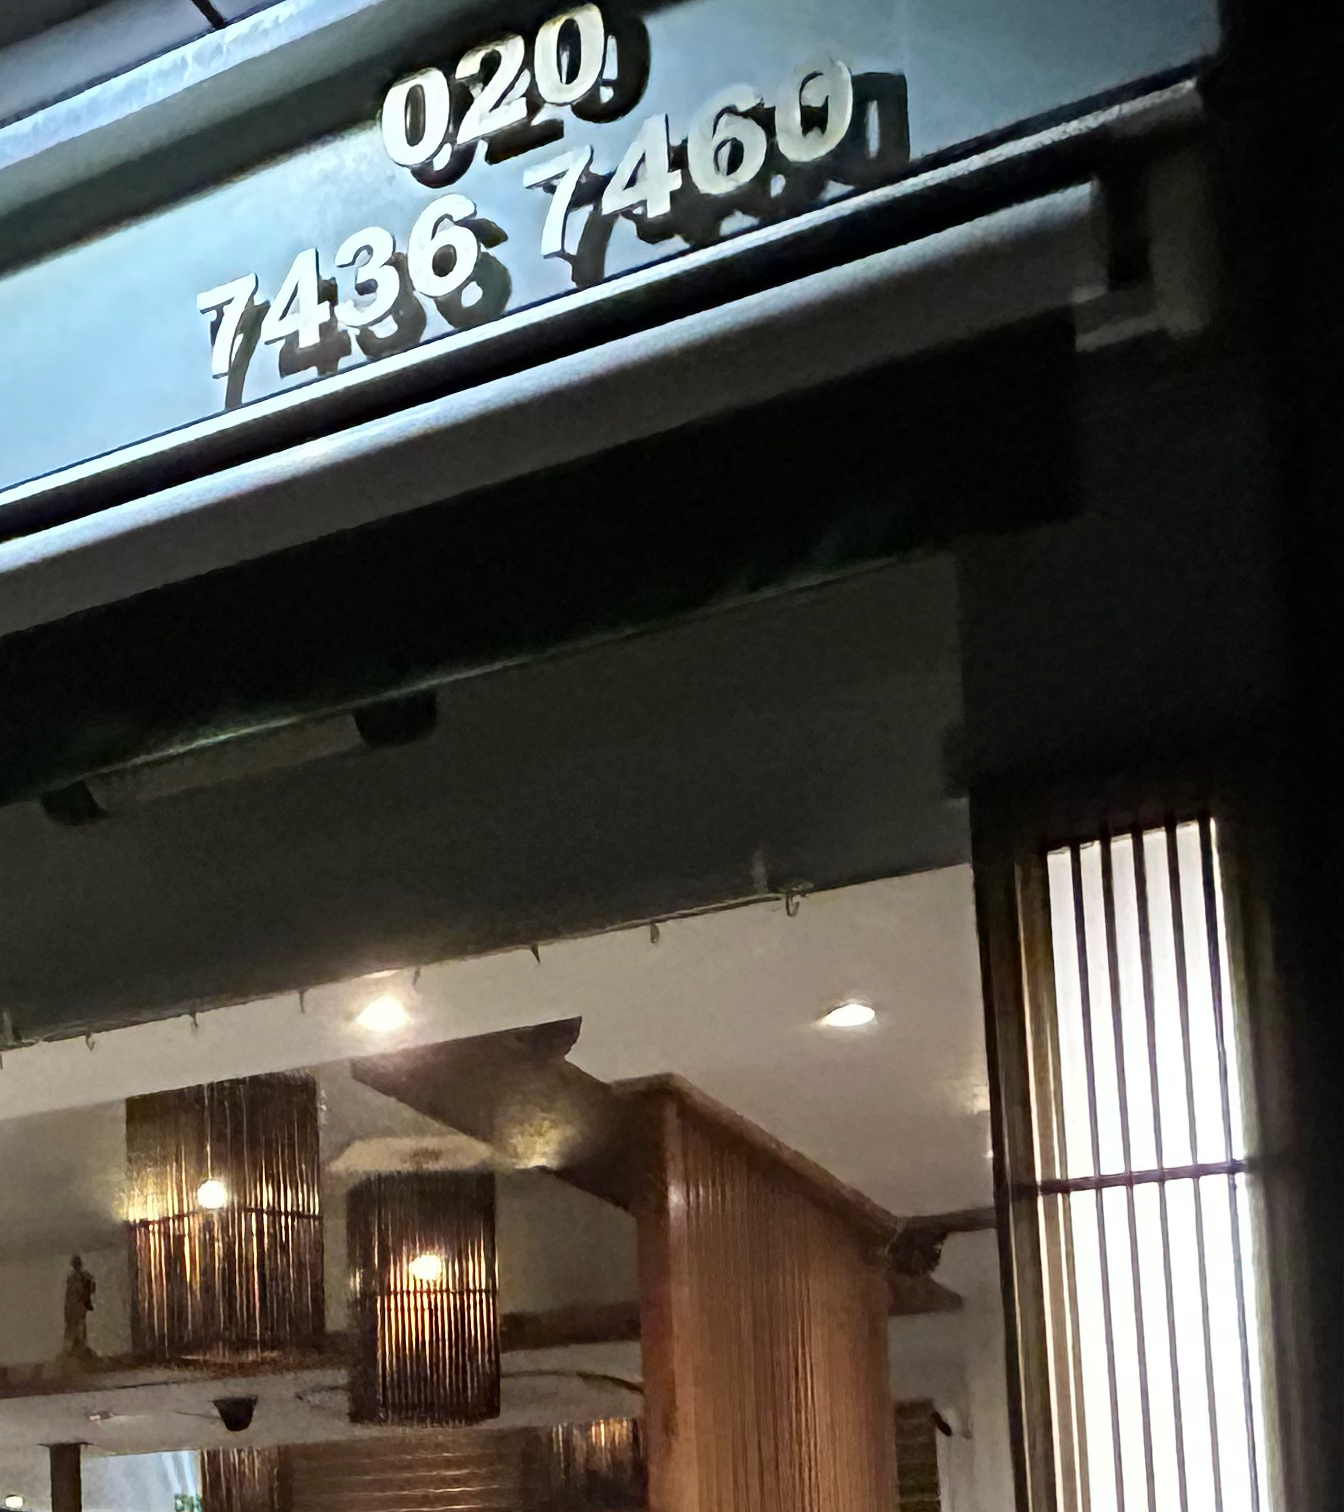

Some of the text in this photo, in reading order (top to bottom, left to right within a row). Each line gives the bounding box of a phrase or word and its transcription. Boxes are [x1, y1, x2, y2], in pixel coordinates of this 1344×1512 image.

[381, 3, 605, 168] 020
[198, 56, 853, 379] 7436 7460
